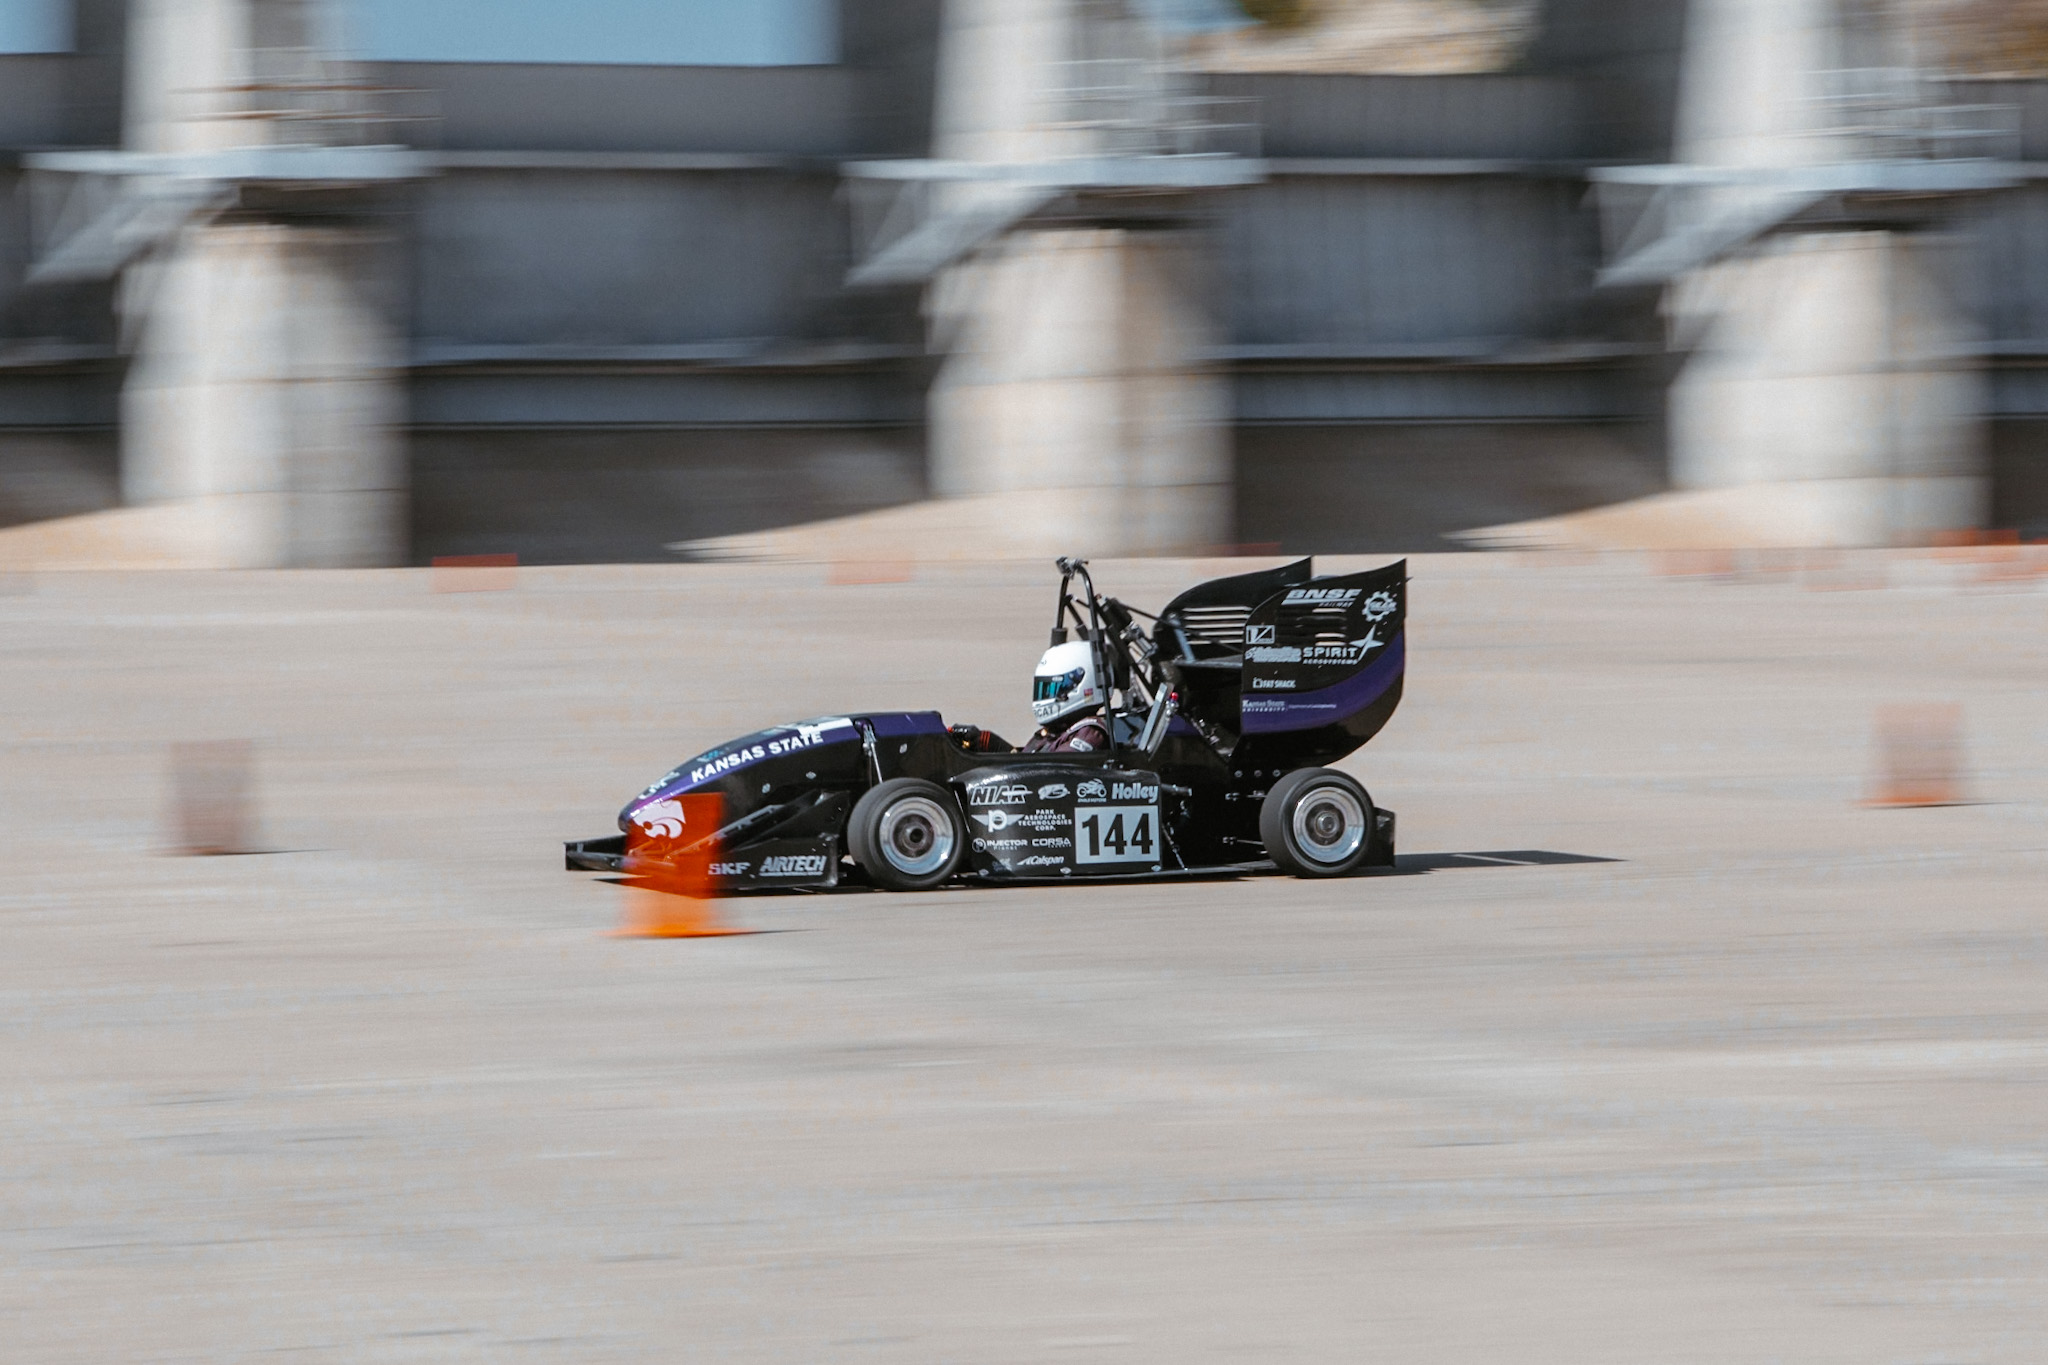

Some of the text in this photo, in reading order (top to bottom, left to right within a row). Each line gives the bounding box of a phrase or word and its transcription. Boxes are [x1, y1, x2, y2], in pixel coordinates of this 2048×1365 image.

[1286, 588, 1362, 599] BNSF
[1303, 647, 1358, 658] SPIRIT
[691, 745, 766, 783] KANSAS
[769, 731, 824, 754] STATE
[970, 785, 1027, 806] NIAR
[1111, 782, 1159, 803] Holley
[1018, 819, 1072, 827] TECHNOLOGIES
[1082, 813, 1154, 857] 144
[986, 839, 1028, 847] INJECTOR
[1032, 837, 1071, 847] CORSA
[759, 855, 828, 874] AIRTECH
[1031, 855, 1065, 866] Calspan
[708, 862, 751, 875] SKF
